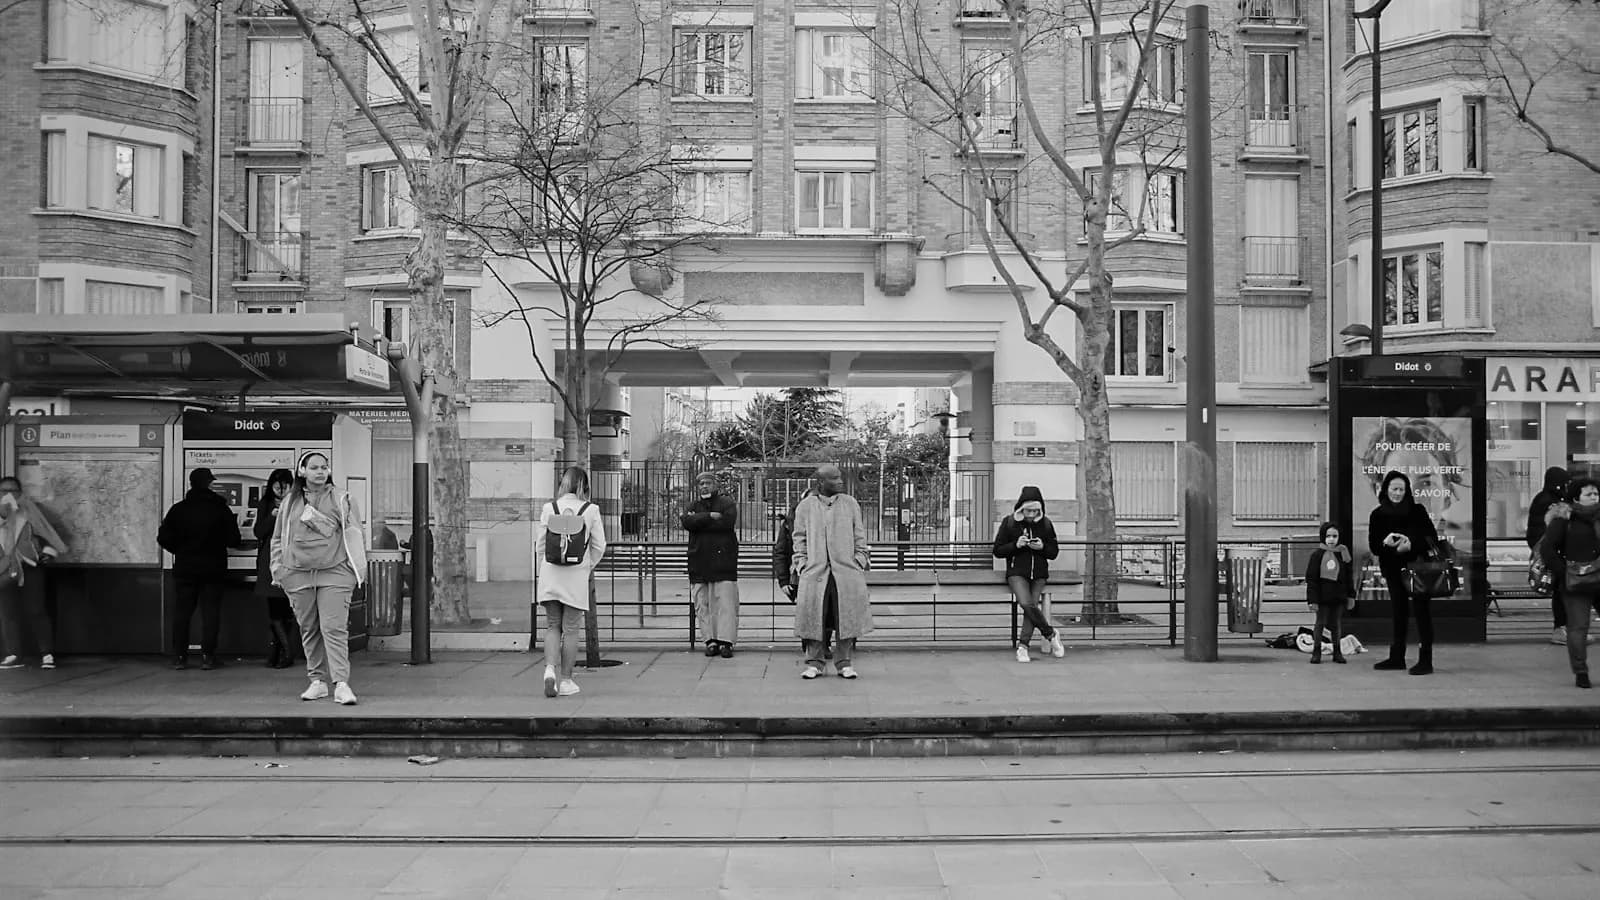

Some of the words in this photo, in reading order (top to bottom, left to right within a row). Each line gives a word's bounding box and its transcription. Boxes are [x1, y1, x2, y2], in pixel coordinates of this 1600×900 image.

[1394, 362, 1419, 371] Didot
[234, 420, 264, 430] Didot
[50, 431, 71, 440] Plan
[1375, 442, 1402, 451] POUR
[1404, 440, 1435, 451] CRÉER
[1437, 442, 1451, 451] DE
[1409, 466, 1432, 474] PLUS
[1414, 488, 1451, 497] SAVOIR
